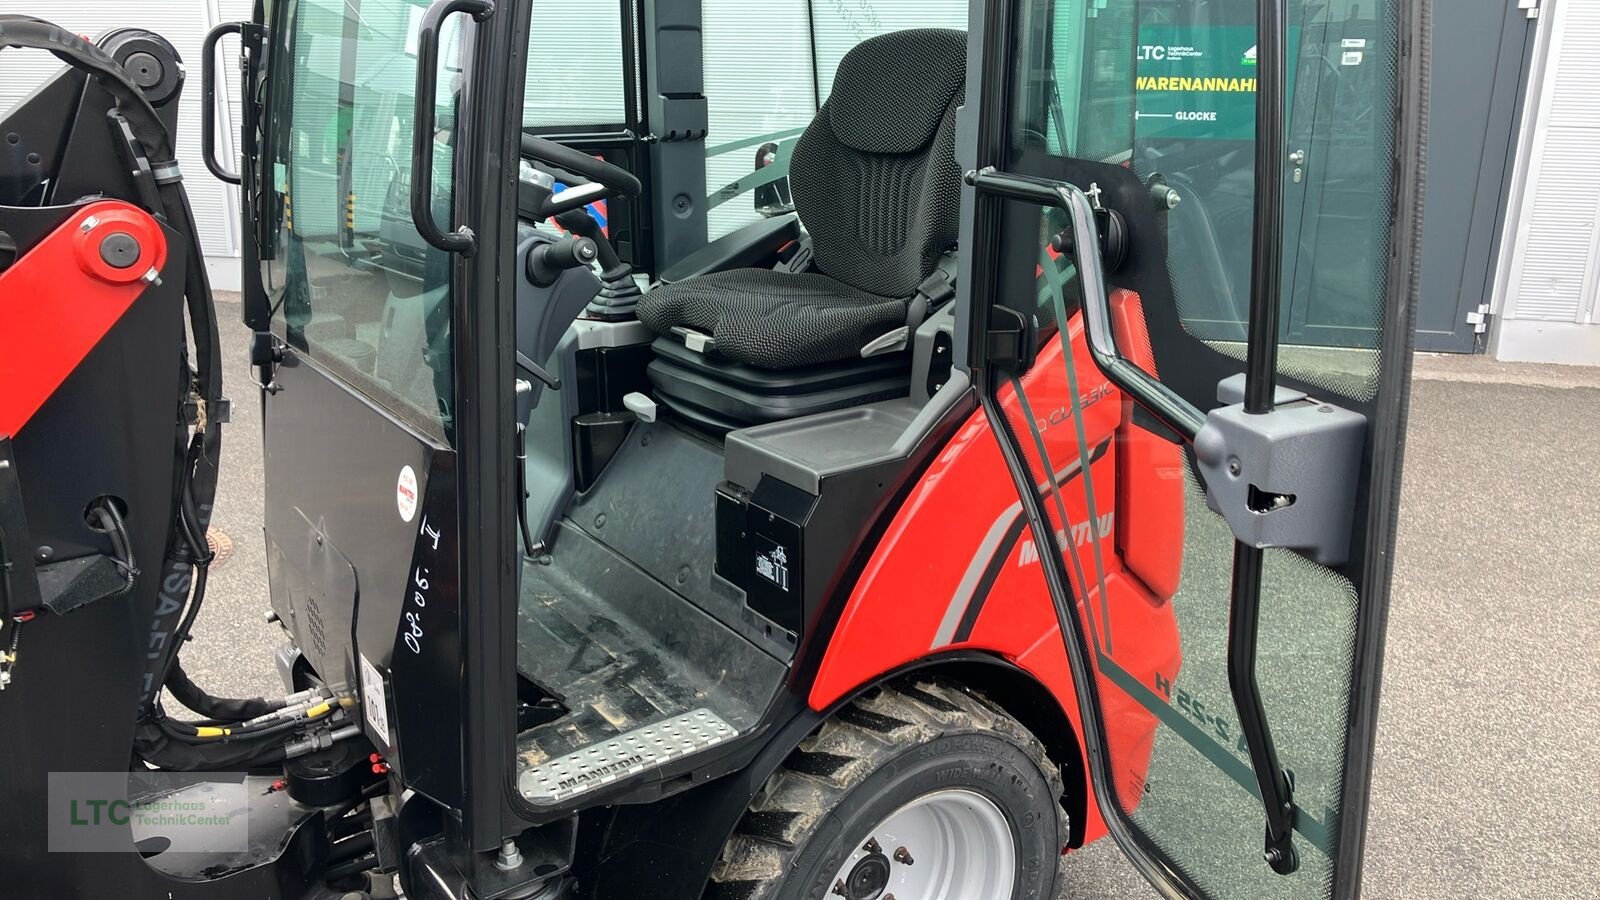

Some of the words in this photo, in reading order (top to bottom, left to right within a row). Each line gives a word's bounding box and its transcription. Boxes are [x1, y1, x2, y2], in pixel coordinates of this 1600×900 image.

[1136, 45, 1165, 60] LTC
[1175, 111, 1217, 121] GLOCKE
[558, 754, 643, 790] MANITOU
